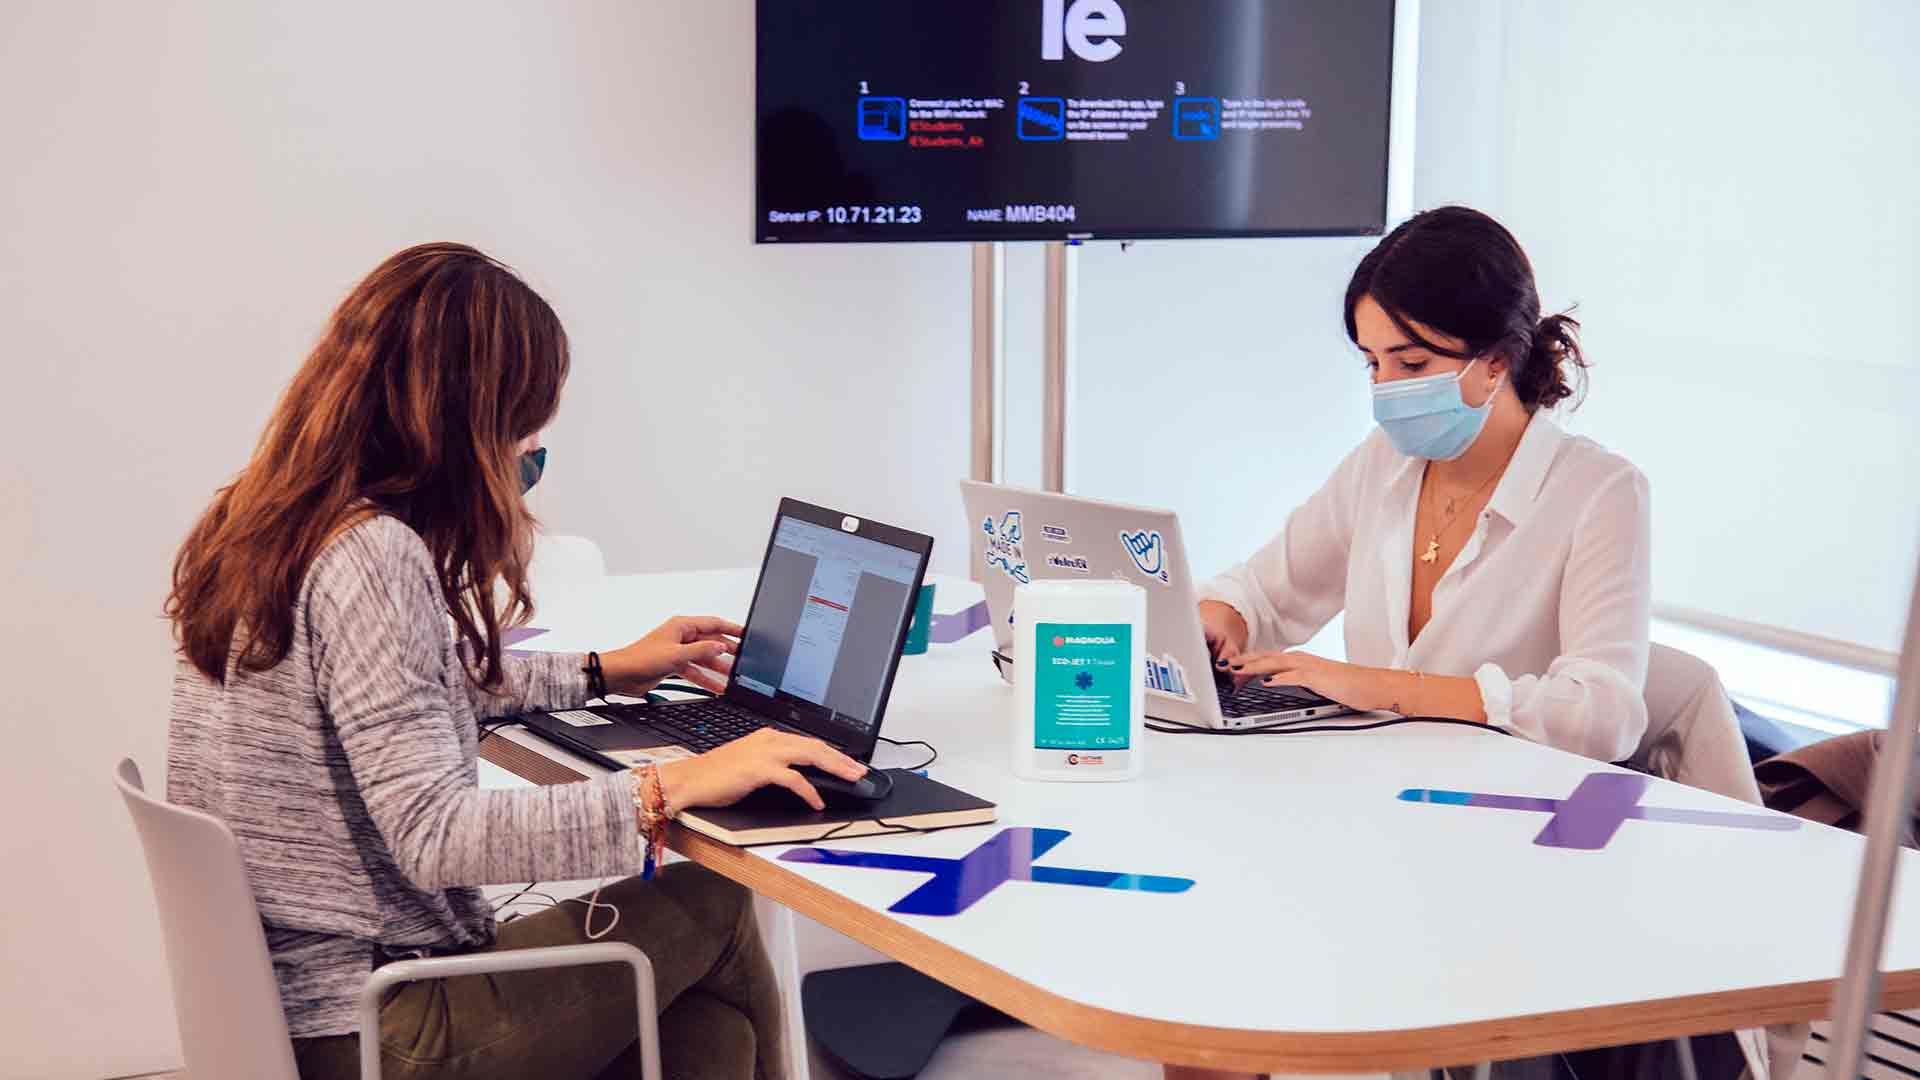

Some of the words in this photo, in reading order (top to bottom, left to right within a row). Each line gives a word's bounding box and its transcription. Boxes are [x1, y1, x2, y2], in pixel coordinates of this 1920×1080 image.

[860, 81, 869, 94] 1
[1018, 81, 1030, 95] 2
[1175, 81, 1185, 95] 3
[826, 206, 922, 224] 10.71.21.23
[1005, 205, 1076, 222] MMB404
